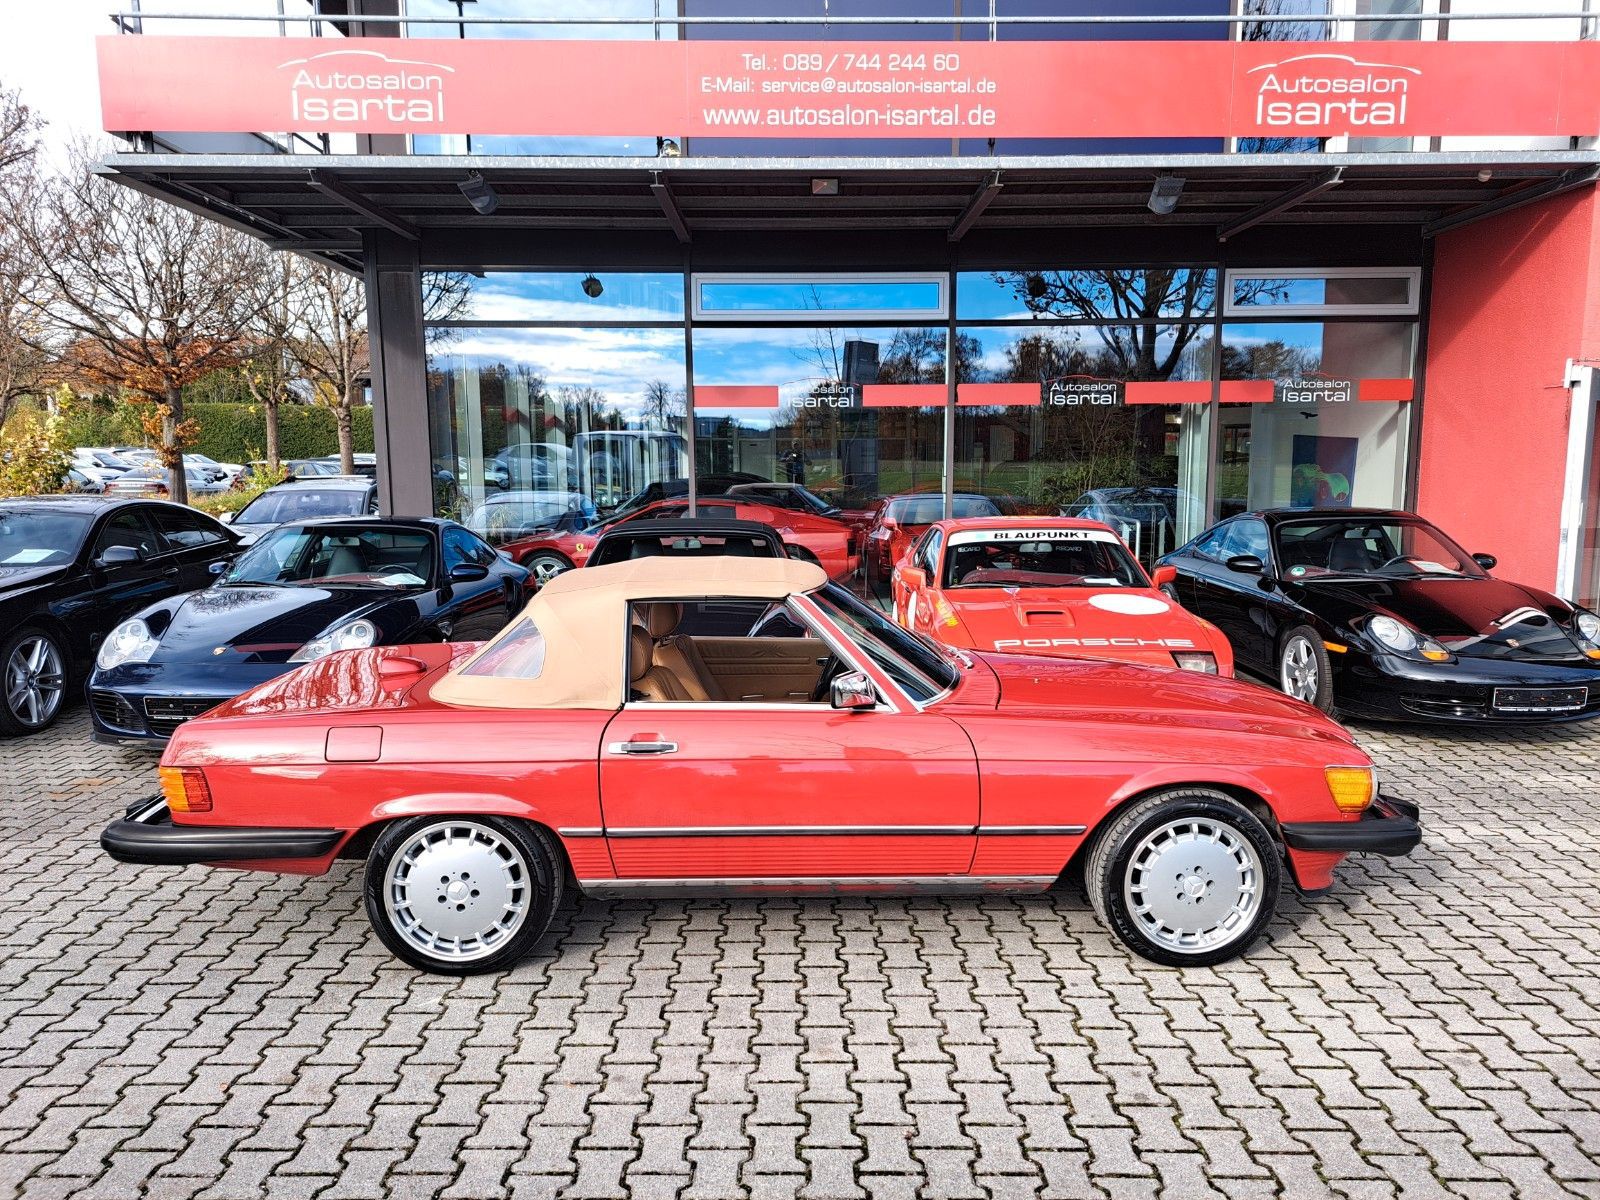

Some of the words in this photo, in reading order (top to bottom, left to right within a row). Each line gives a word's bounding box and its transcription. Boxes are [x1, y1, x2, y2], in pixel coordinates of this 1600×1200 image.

[742, 53, 777, 71] Tel.:
[783, 53, 822, 71] 089
[825, 54, 839, 72] /
[843, 53, 882, 71] 744
[888, 53, 927, 71] 244
[933, 53, 960, 71] 60
[292, 69, 443, 90] Autosalon
[701, 77, 755, 93] E-Mail:
[762, 77, 997, 94] service@autosalon-isartal.de
[1259, 73, 1408, 93] Autosalon
[291, 89, 444, 122] Isartal
[1256, 93, 1407, 125] Isartal
[703, 104, 997, 126] www.autosalon-isartal.de
[1050, 382, 1117, 391] Autosalon
[1284, 379, 1351, 388] Autosalon
[1049, 391, 1117, 405] Isartal
[1282, 388, 1351, 402] Isartal
[993, 531, 1090, 540] BLAUPUNKT
[993, 638, 1195, 652] PORSCHE
